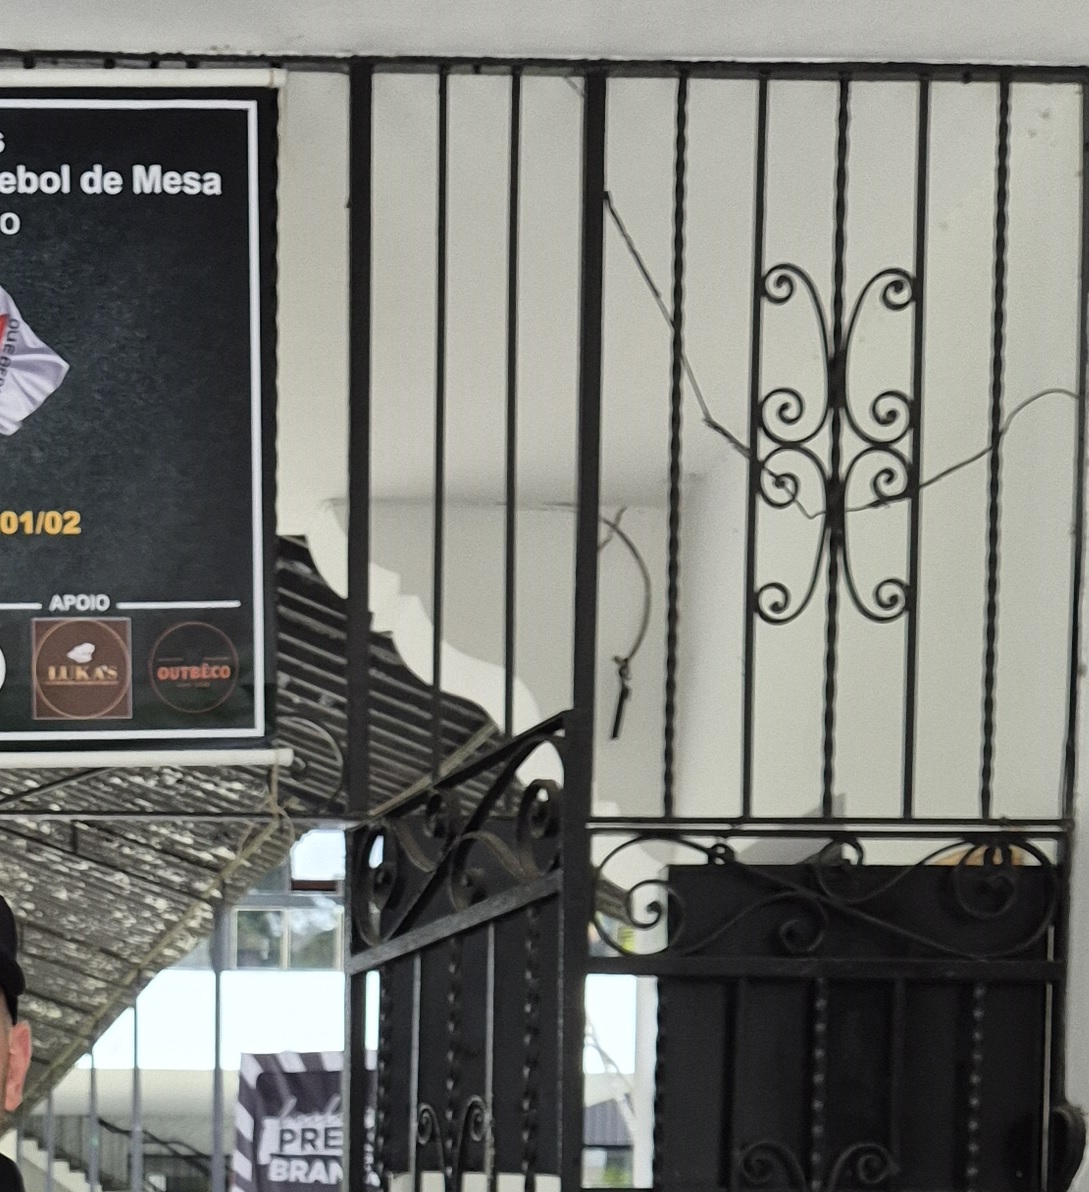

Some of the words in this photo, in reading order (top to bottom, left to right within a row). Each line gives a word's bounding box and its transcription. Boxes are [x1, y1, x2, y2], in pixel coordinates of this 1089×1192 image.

[80, 165, 123, 195] de
[132, 165, 222, 196] Mesa
[49, 594, 111, 612] APOIO
[157, 662, 231, 681] OUTBÊCO
